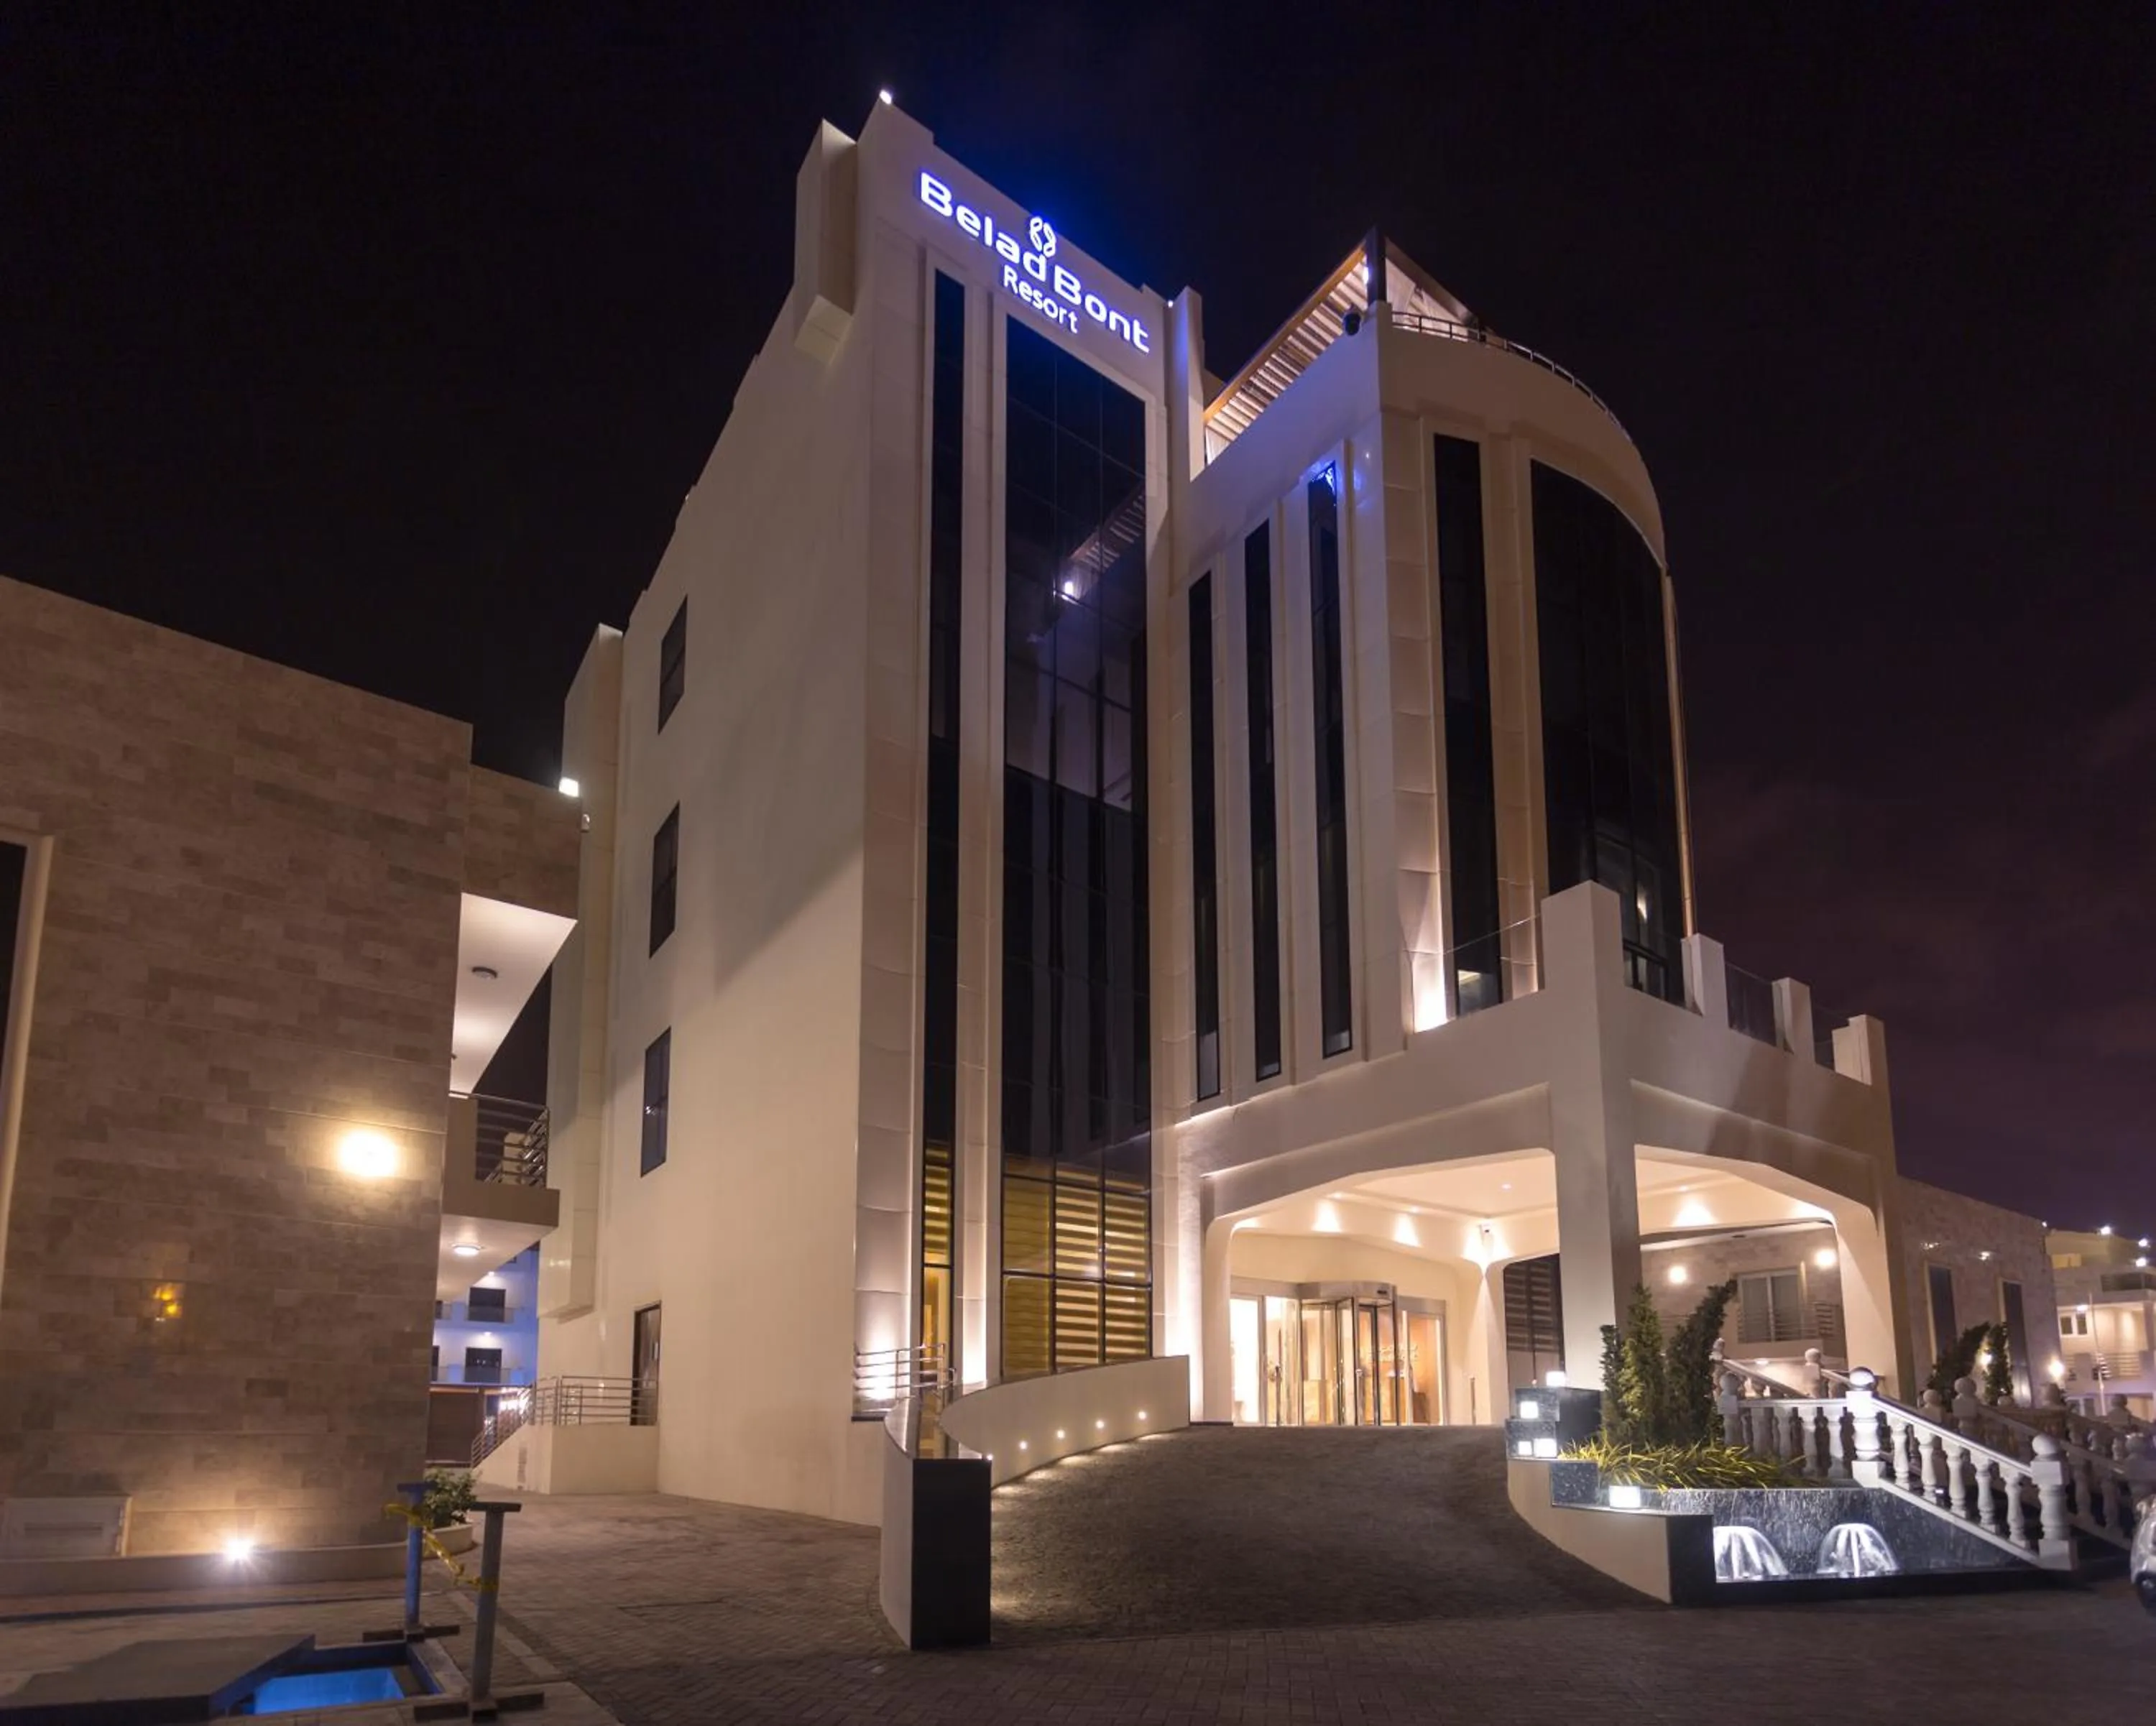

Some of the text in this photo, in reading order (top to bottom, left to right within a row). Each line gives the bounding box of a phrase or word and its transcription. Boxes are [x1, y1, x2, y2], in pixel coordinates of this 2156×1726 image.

[920, 171, 1150, 354] Belad Bont
[1003, 264, 1078, 335] Resort
